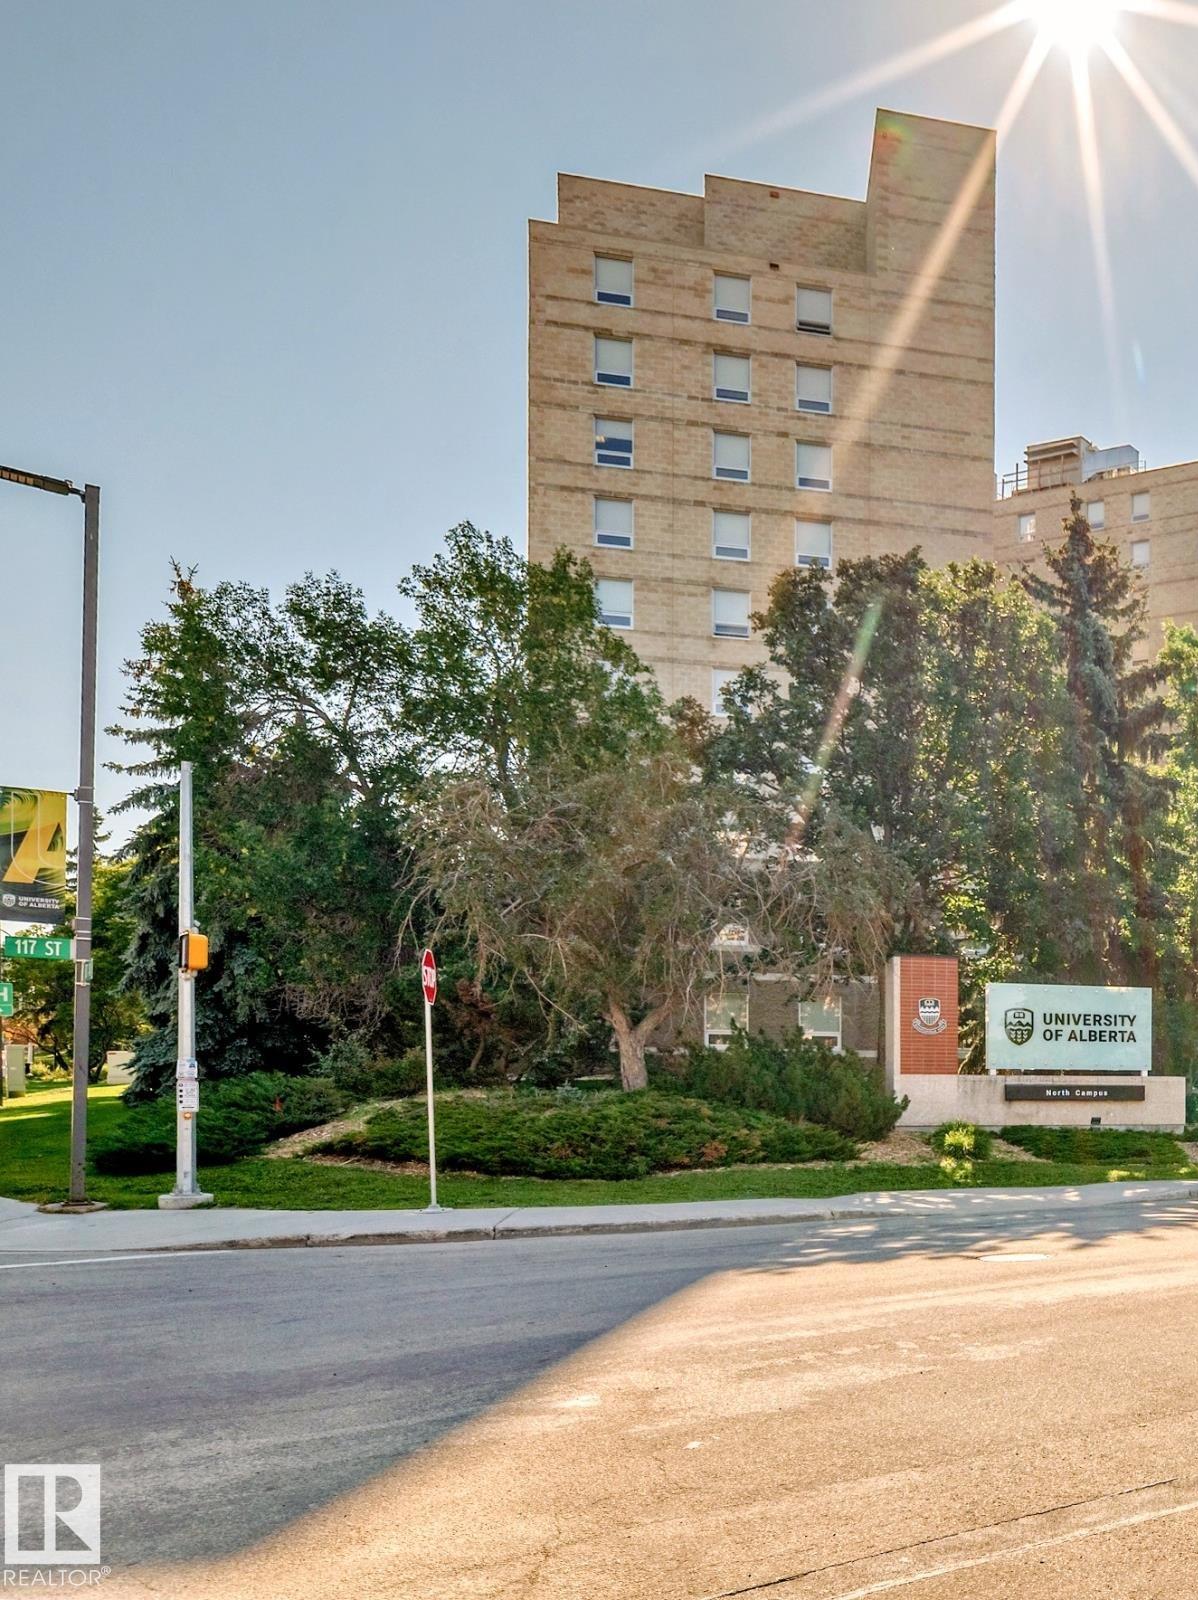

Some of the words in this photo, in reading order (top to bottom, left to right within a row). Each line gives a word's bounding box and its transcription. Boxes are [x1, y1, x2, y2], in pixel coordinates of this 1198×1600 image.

[18, 895, 60, 904] UNIVERSITY
[15, 939, 37, 955] 117
[44, 940, 63, 956] ST
[1043, 1013, 1137, 1027] UNIVERSITY
[1043, 1029, 1063, 1042] OF
[1067, 1029, 1137, 1043] ALBERTA
[1075, 1089, 1108, 1097] Campus
